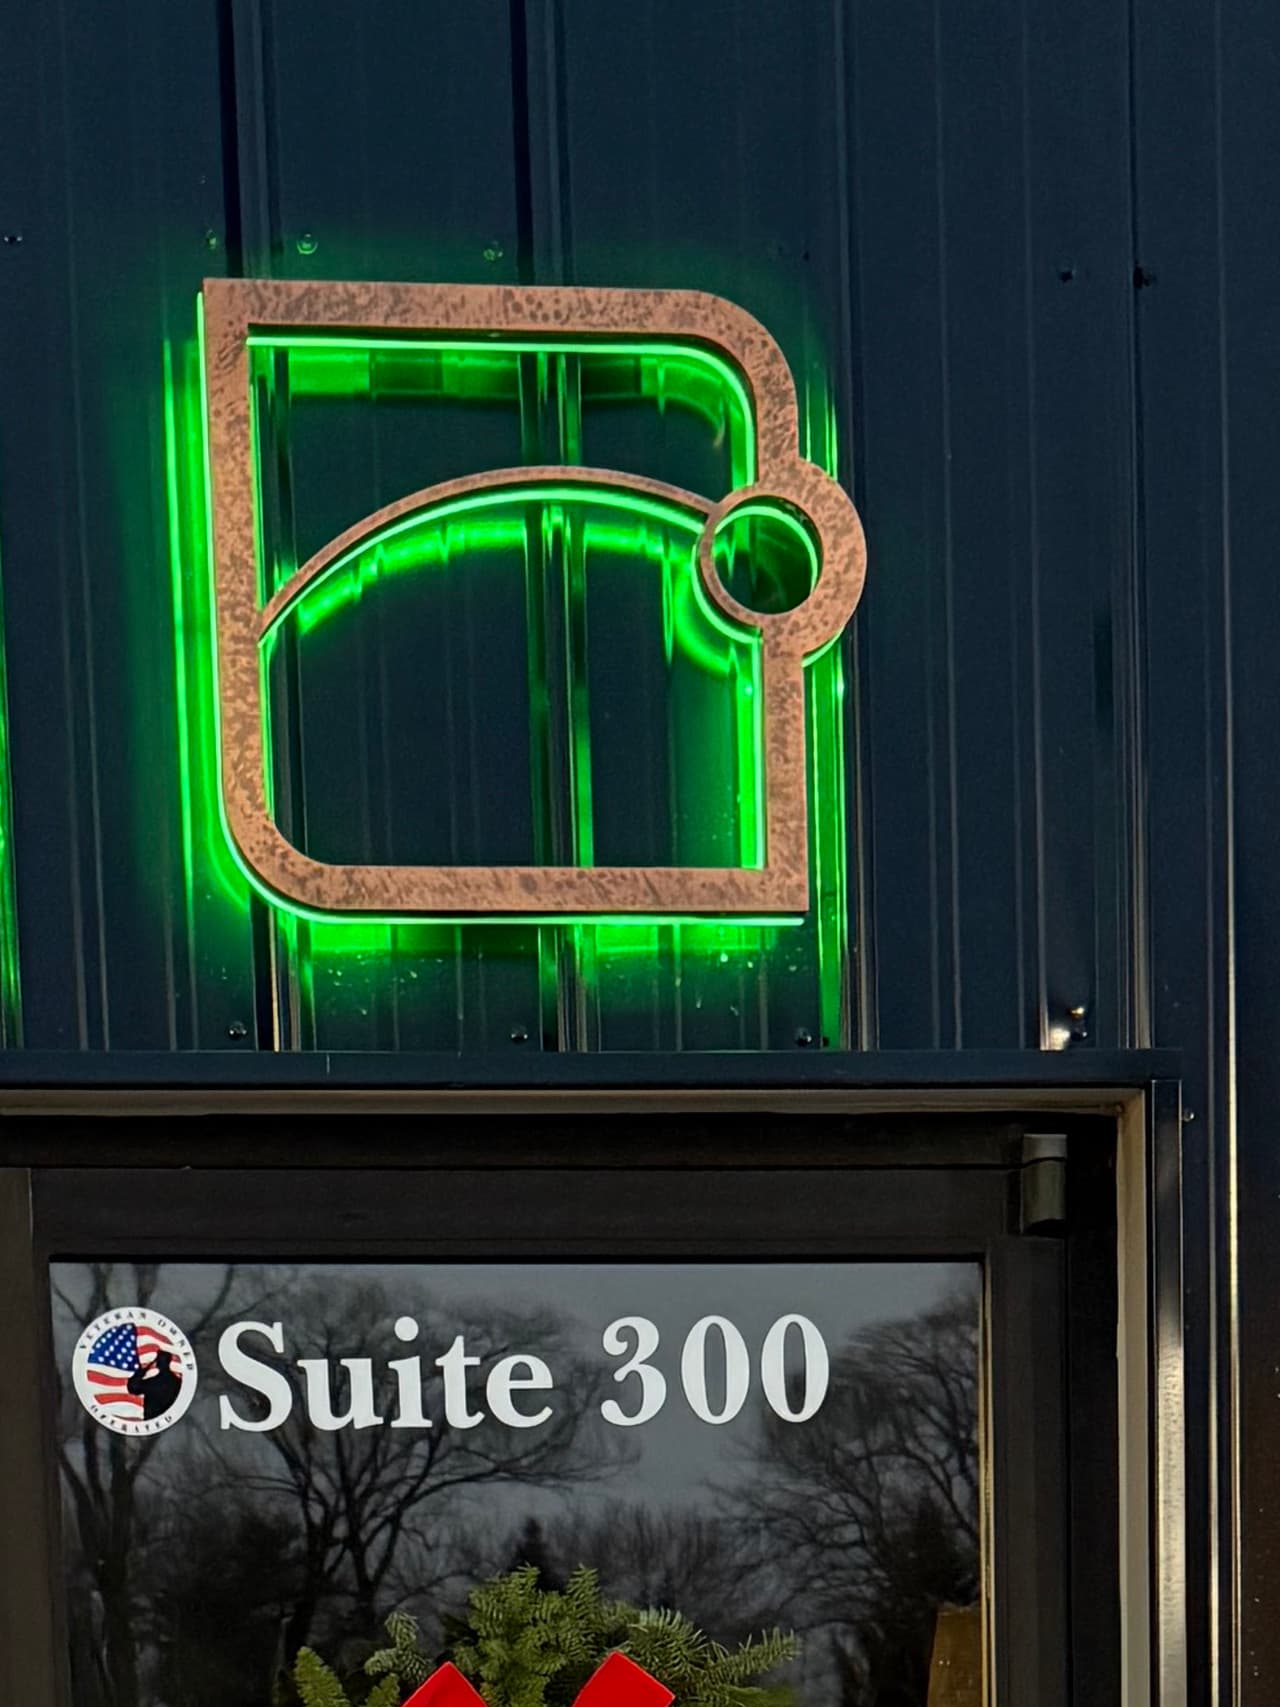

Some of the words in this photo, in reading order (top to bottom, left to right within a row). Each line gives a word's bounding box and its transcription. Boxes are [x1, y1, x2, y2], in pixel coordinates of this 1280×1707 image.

[80, 1311, 147, 1349] VETERAN
[218, 1316, 553, 1432] Suite
[601, 1314, 829, 1426] 300
